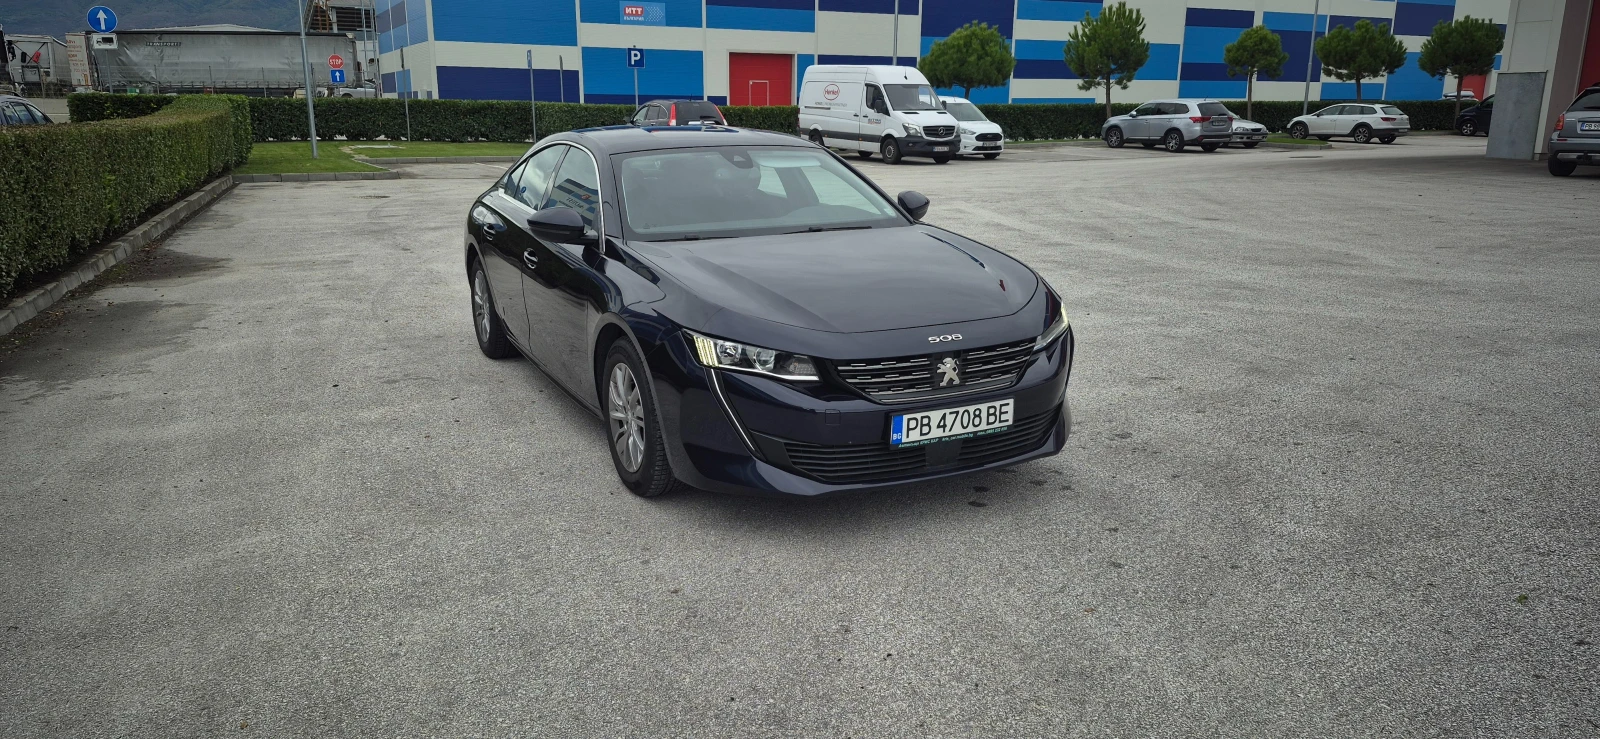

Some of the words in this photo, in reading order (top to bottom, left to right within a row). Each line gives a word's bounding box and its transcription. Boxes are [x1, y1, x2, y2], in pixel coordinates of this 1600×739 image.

[630, 50, 641, 65] P
[928, 334, 962, 343] 508
[906, 415, 932, 438] PB
[936, 408, 982, 433] 4708
[986, 402, 1010, 426] BE
